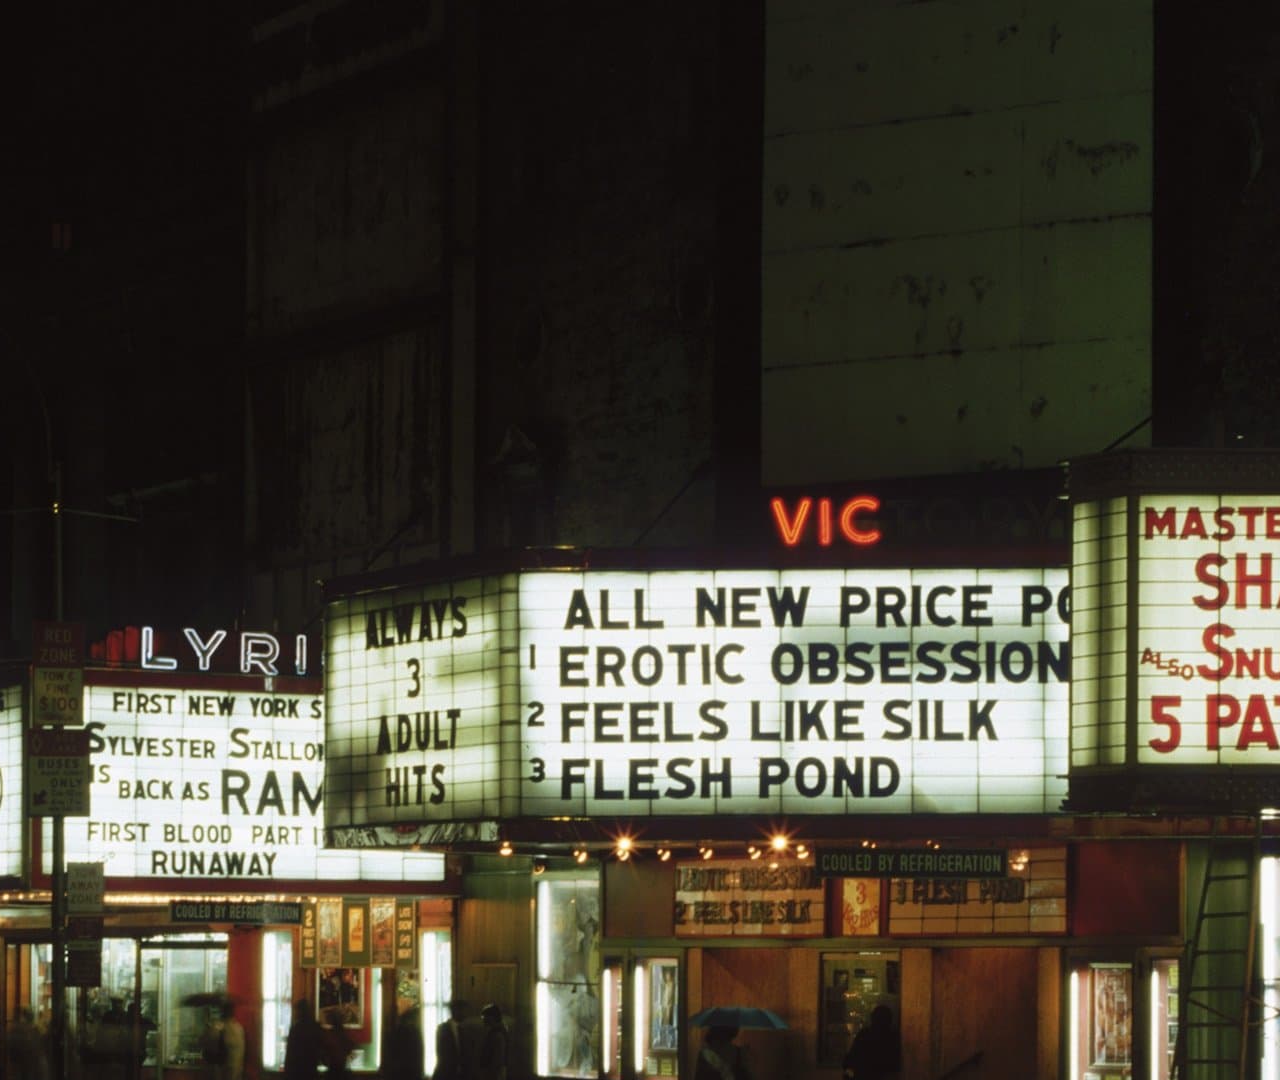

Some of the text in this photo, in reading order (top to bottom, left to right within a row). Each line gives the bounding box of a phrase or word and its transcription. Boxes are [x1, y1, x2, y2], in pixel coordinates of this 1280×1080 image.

[365, 597, 468, 651] ALWAYS
[564, 588, 665, 630] ALL
[696, 586, 812, 628] NEW
[839, 584, 994, 628] PRICE
[39, 647, 76, 664] ZONE
[559, 643, 745, 687] EROTIC
[770, 640, 1070, 685] OBSESSION
[1140, 646, 1195, 681] ALSO
[405, 658, 422, 699] 3
[113, 692, 174, 714] FIRST
[188, 694, 235, 716] NEW
[250, 698, 300, 718] YORK
[526, 698, 1000, 743] 2 FEELS LIKE SILK
[1149, 695, 1182, 754] 5
[87, 721, 216, 759] SYLVESTER
[377, 708, 463, 755] ADULT
[119, 780, 175, 800] BACK
[182, 781, 210, 801] AS
[384, 764, 446, 808] HITS
[528, 756, 902, 800] 3 FLESH POND
[88, 822, 301, 845] FIRST BLOOD PART
[151, 851, 277, 876] RUNAWAY
[822, 854, 1001, 873] COOLED BY REFRIGERATION
[175, 903, 211, 920] COOLED
[214, 903, 229, 920] BY
